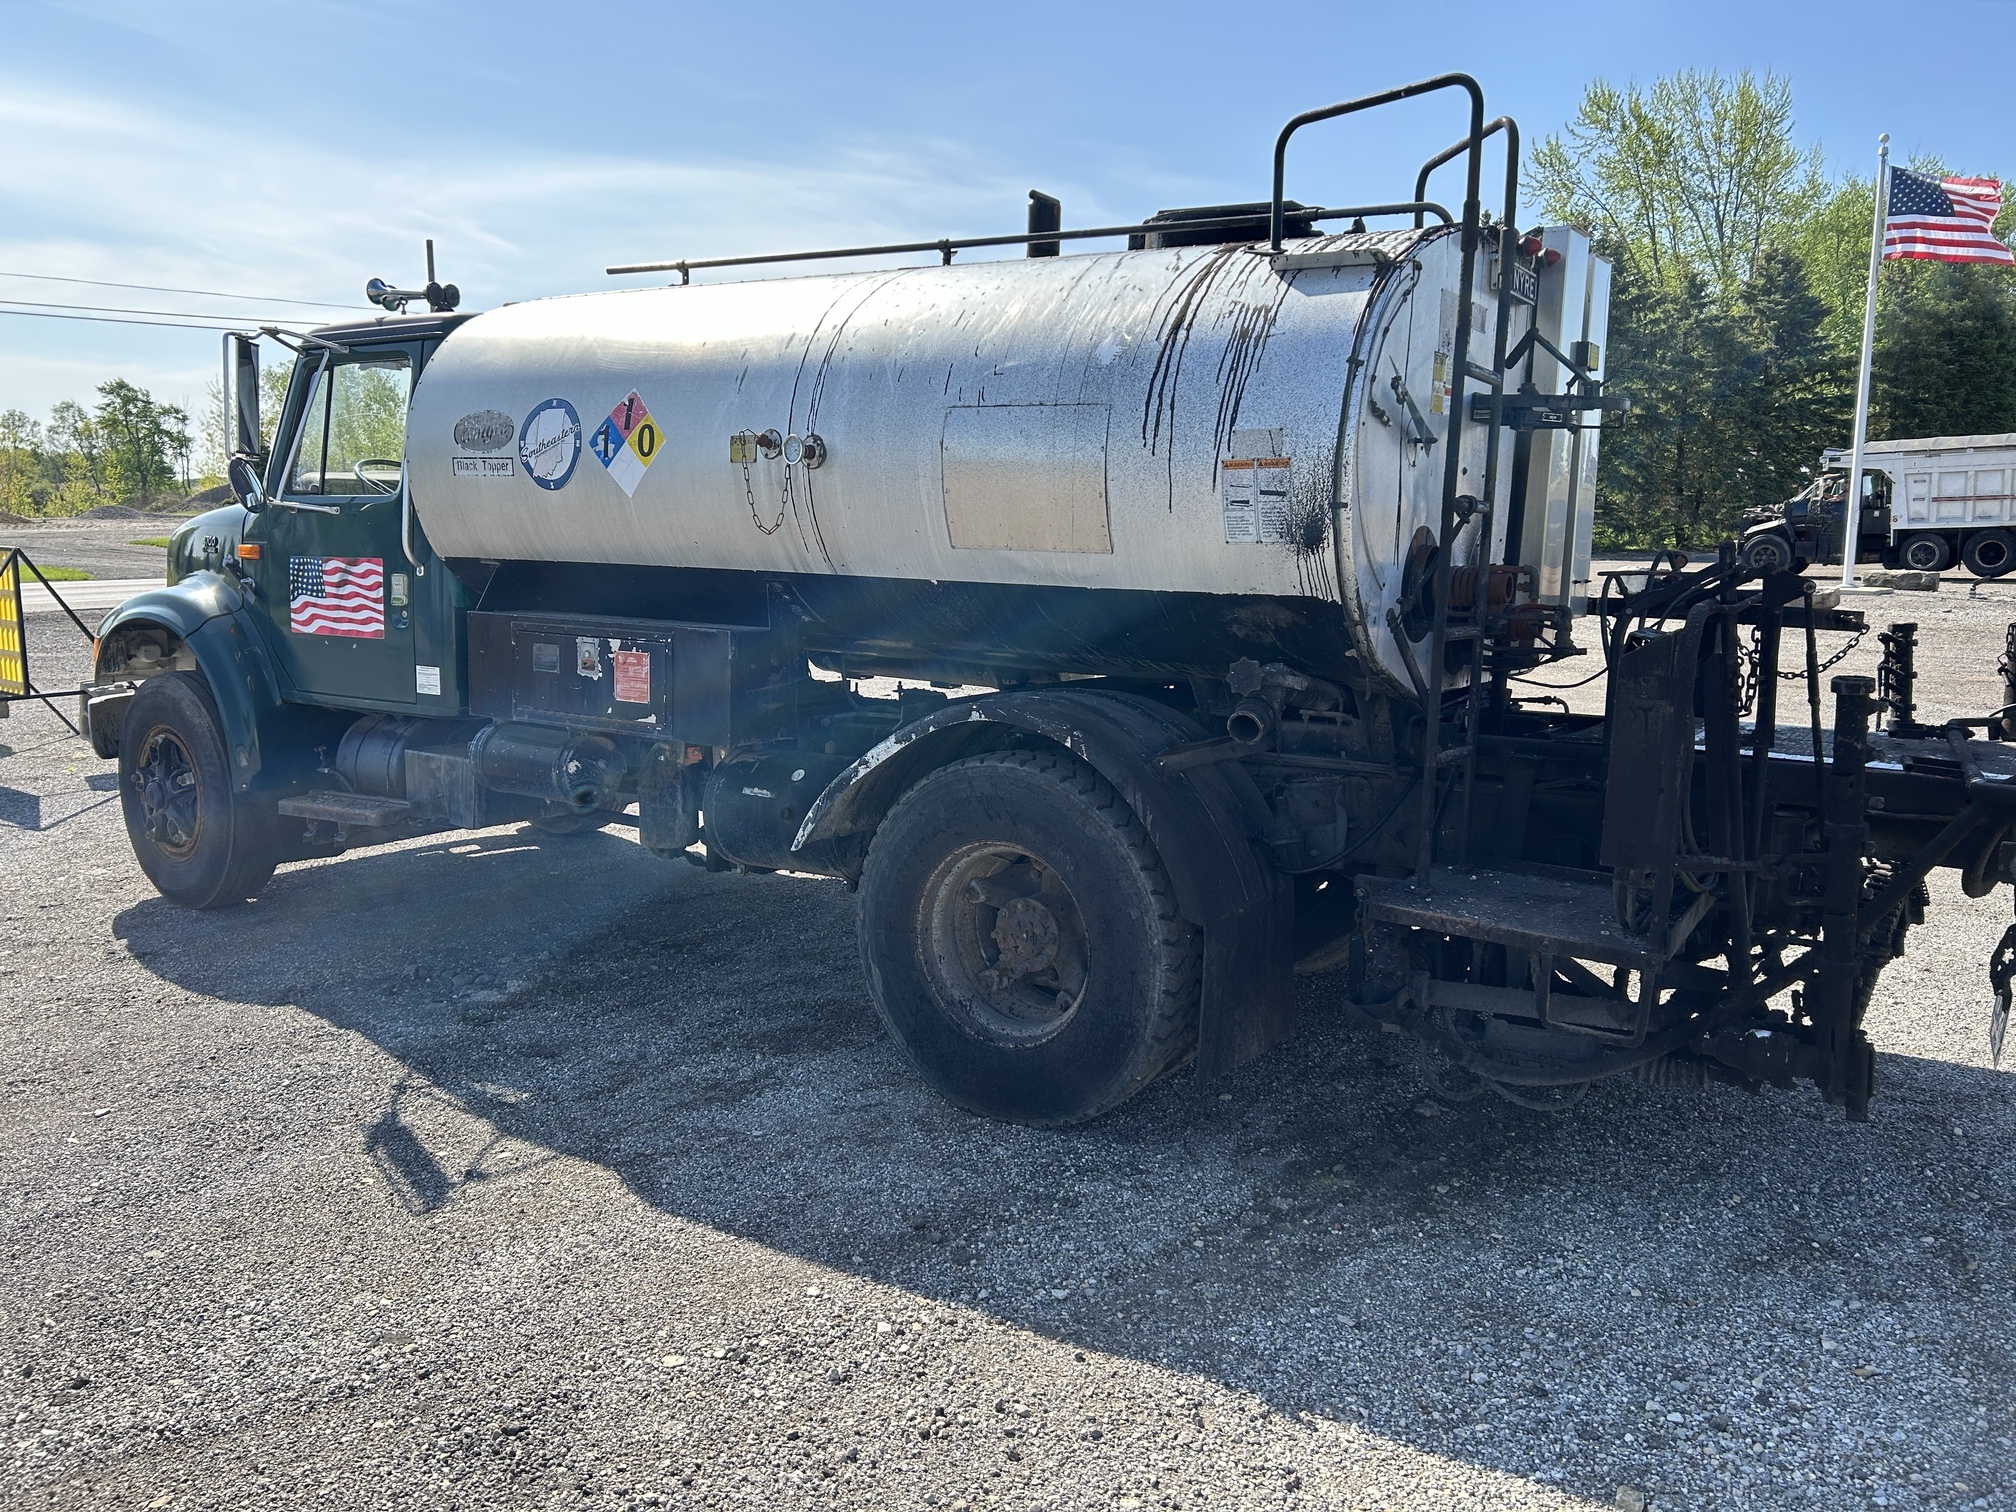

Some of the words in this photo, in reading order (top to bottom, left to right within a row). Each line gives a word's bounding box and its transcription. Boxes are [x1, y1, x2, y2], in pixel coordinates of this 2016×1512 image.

[1513, 269, 1535, 299] NYRE
[623, 398, 635, 430] 1
[520, 423, 581, 462] Southeastern
[598, 424, 610, 459] 1
[637, 423, 655, 457] 0
[456, 460, 478, 471] Black
[481, 460, 509, 473] Topper
